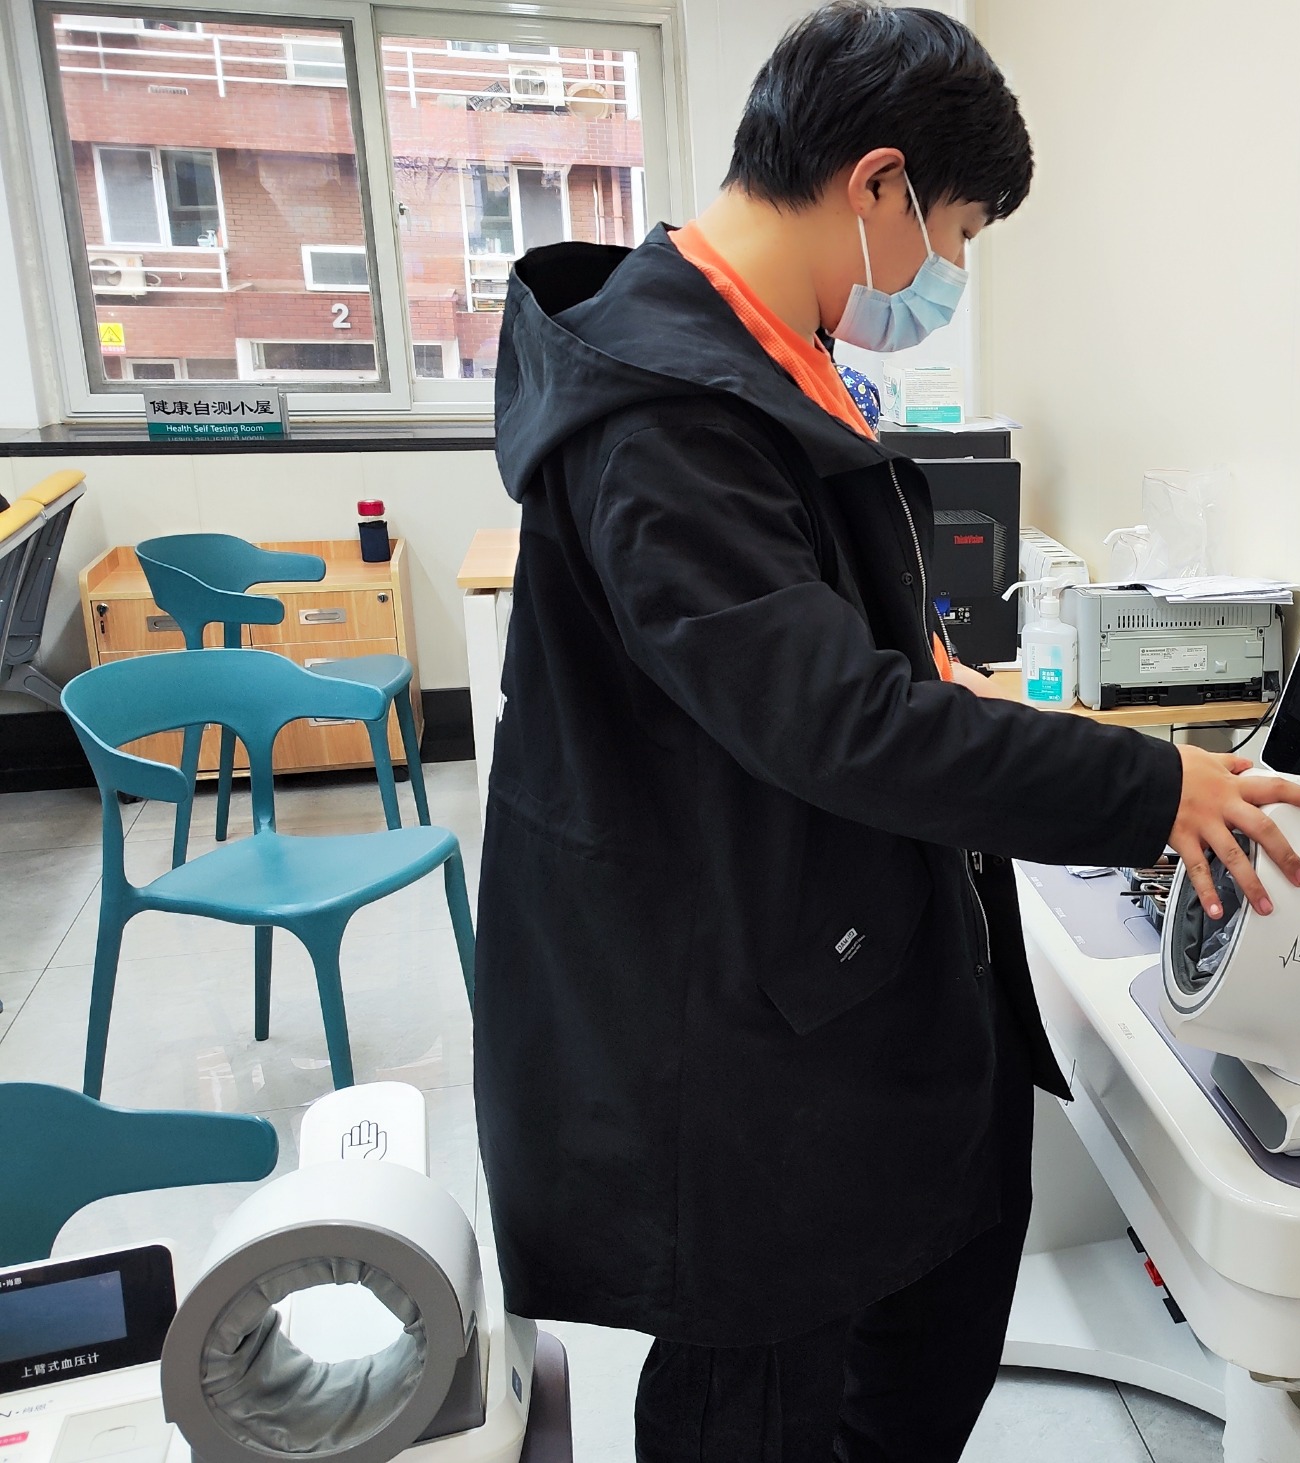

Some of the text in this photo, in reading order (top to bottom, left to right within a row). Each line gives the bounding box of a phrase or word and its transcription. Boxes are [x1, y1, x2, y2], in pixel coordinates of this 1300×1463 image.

[331, 303, 351, 328] 2
[149, 400, 275, 416] 健康自测小屋
[166, 424, 193, 433] Health
[194, 424, 209, 433] Self
[211, 425, 239, 433] Testing
[21, 1352, 100, 1378] 上臂式血压计
